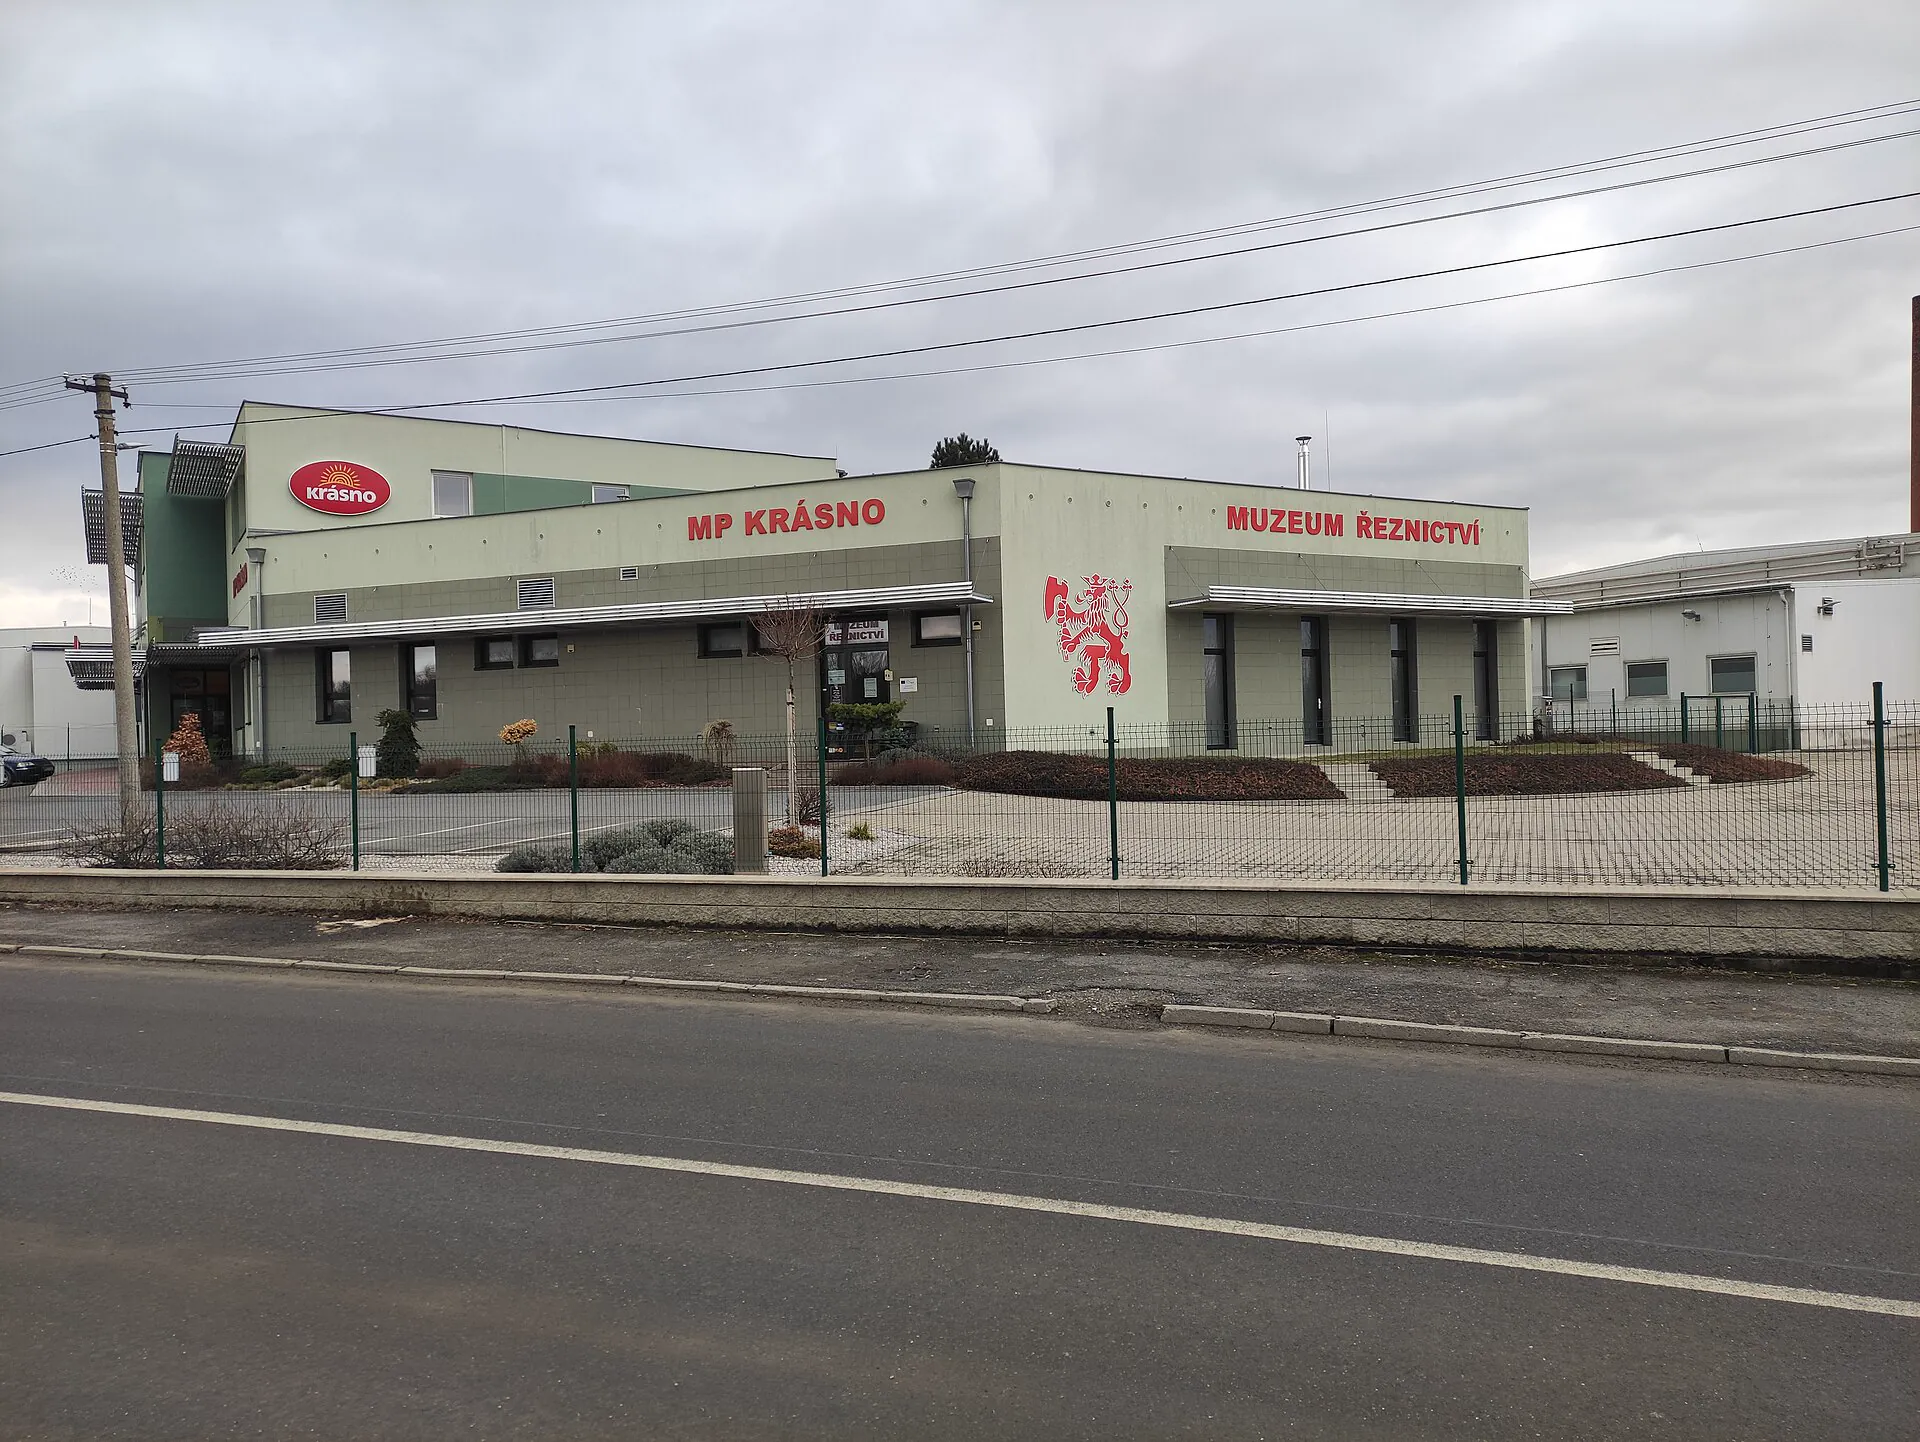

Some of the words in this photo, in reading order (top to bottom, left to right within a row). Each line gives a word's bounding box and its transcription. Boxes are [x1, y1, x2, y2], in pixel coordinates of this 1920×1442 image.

[688, 513, 733, 541] MP
[744, 498, 886, 536] KRÁSNO
[1227, 505, 1344, 537] MUZEUM
[1356, 510, 1480, 546] ŘEZNICTVÍ
[829, 629, 885, 642] ŘENICTVÍ
[833, 621, 879, 631] MZEUM
